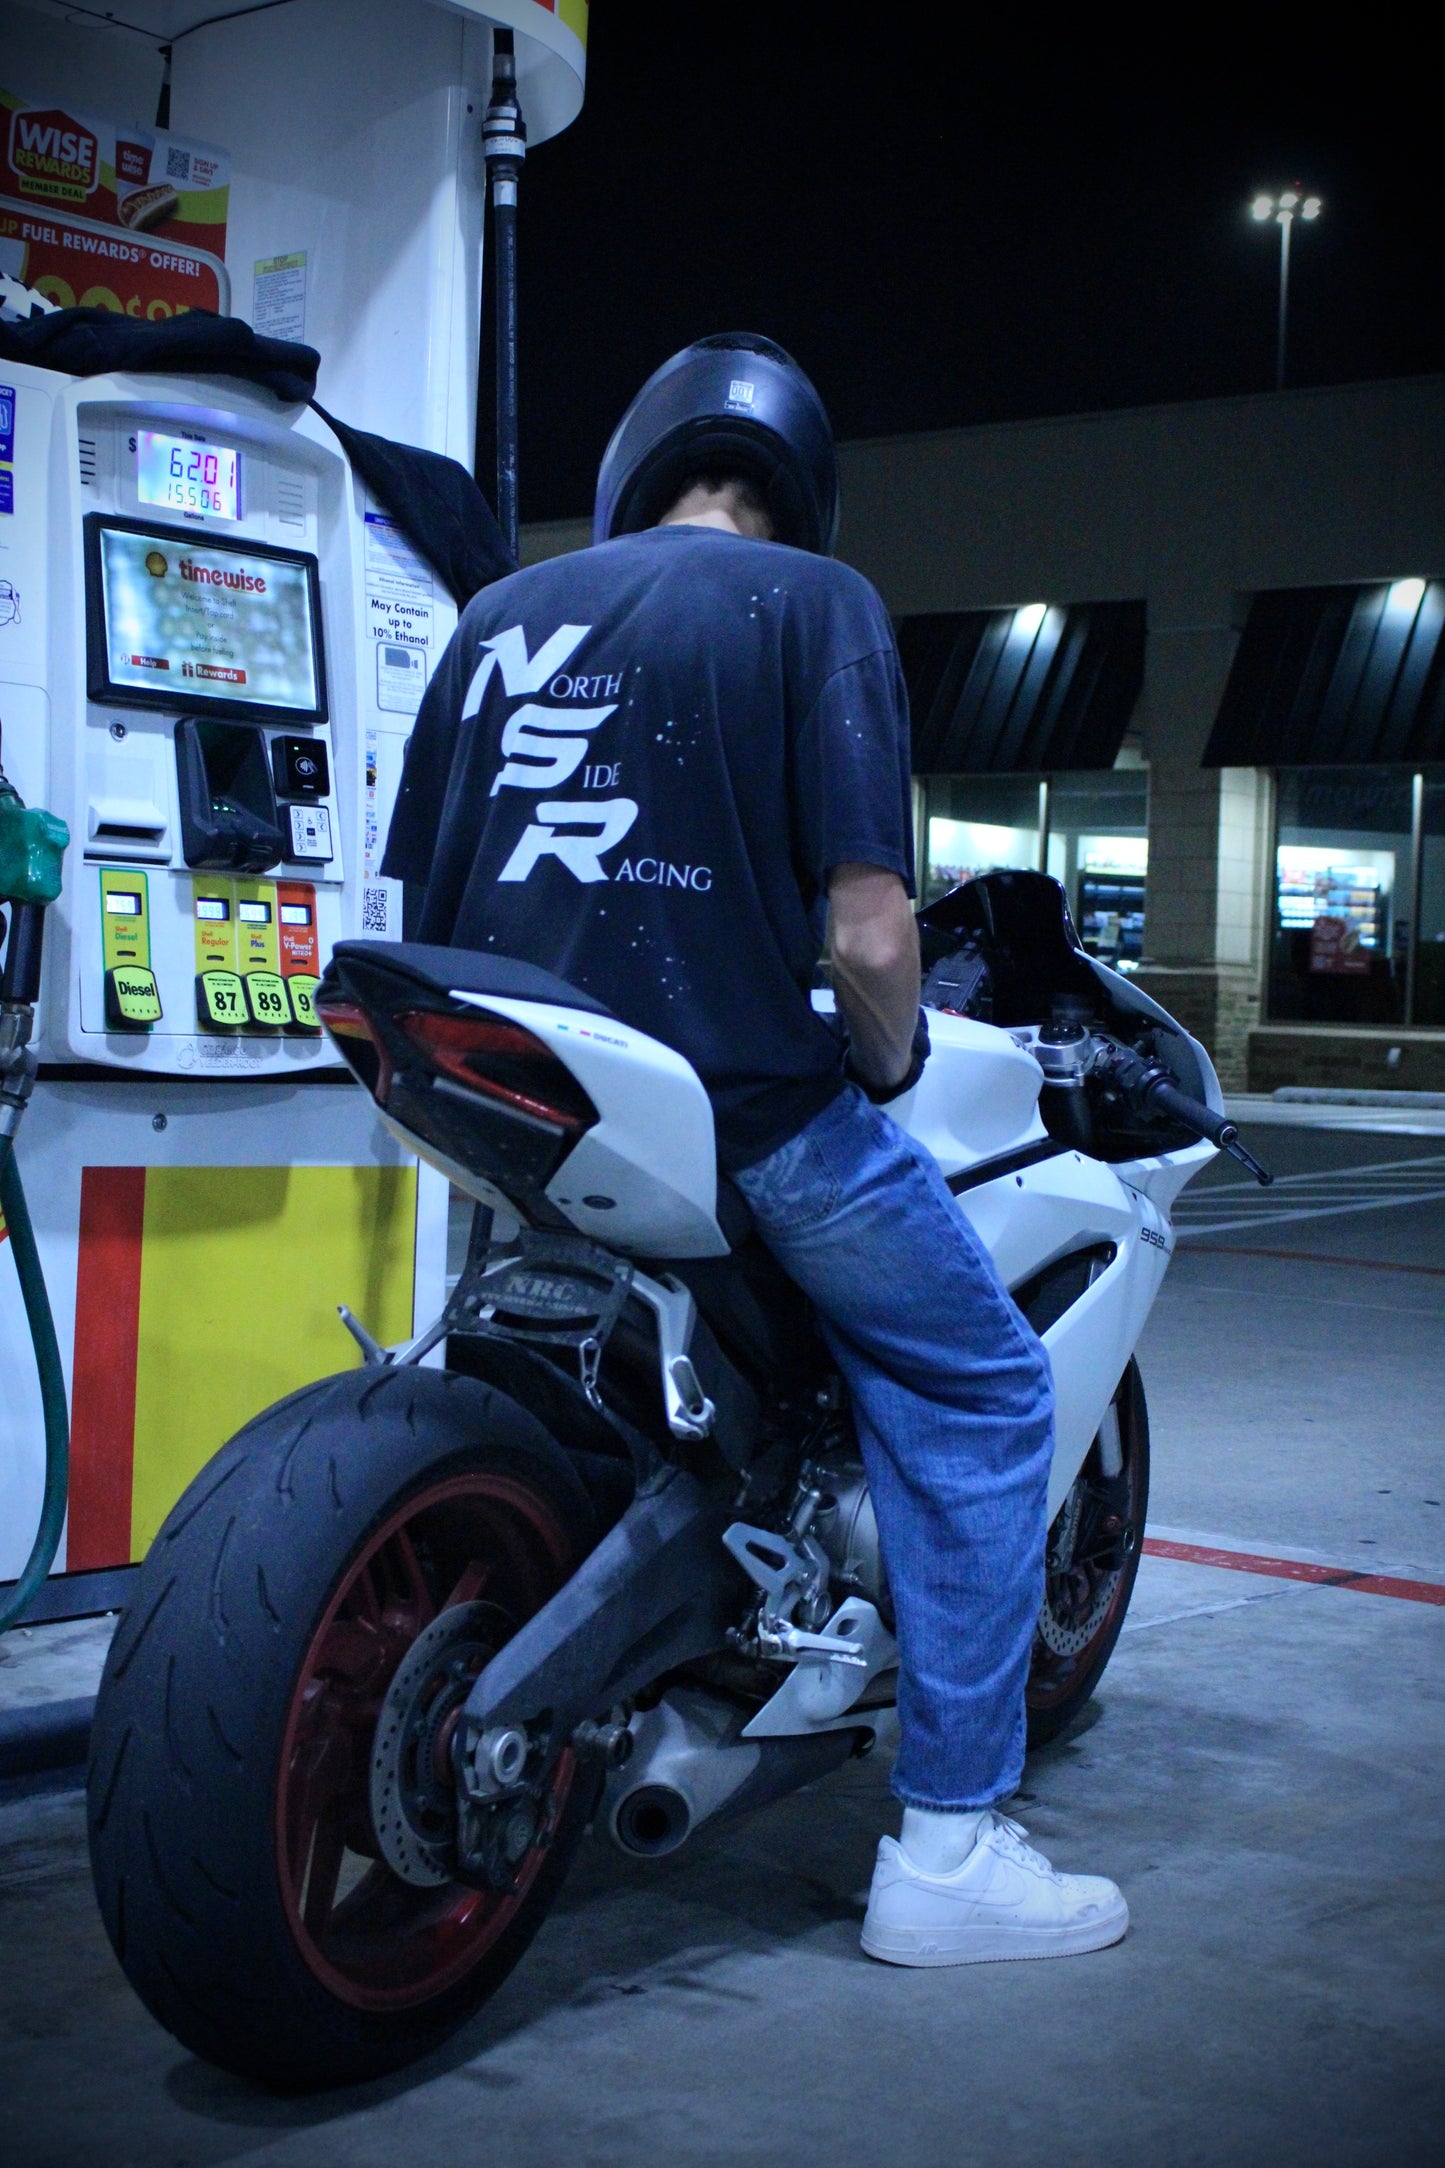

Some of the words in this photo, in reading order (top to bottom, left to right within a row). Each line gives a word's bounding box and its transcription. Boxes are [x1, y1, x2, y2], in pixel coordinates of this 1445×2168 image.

[19, 118, 94, 167] WISE
[123, 150, 144, 165] time
[15, 149, 91, 184] REWARDS
[122, 162, 143, 176] wise
[21, 179, 57, 195] MEMBER
[60, 185, 84, 199] DEAL
[22, 223, 59, 245] FUEL
[150, 252, 201, 277] OFFER!
[128, 437, 137, 453] $
[183, 511, 205, 521] Gallons
[178, 559, 267, 594] timewise
[181, 591, 212, 604] Welcome
[371, 598, 391, 613] May
[394, 603, 429, 618] Contain
[388, 618, 400, 629] up
[402, 619, 412, 629] to
[373, 626, 393, 640] 10%
[395, 631, 429, 646] Ethanol
[140, 658, 158, 668] Help
[197, 666, 238, 680] Rewards
[115, 932, 138, 942] Diesel
[201, 937, 230, 947] Regular
[250, 940, 265, 948] Plus
[283, 942, 313, 951] V-Power
[118, 981, 156, 997] Diesel
[214, 991, 237, 1011] 87
[258, 992, 282, 1011] 89
[1141, 1227, 1165, 1249] 959
